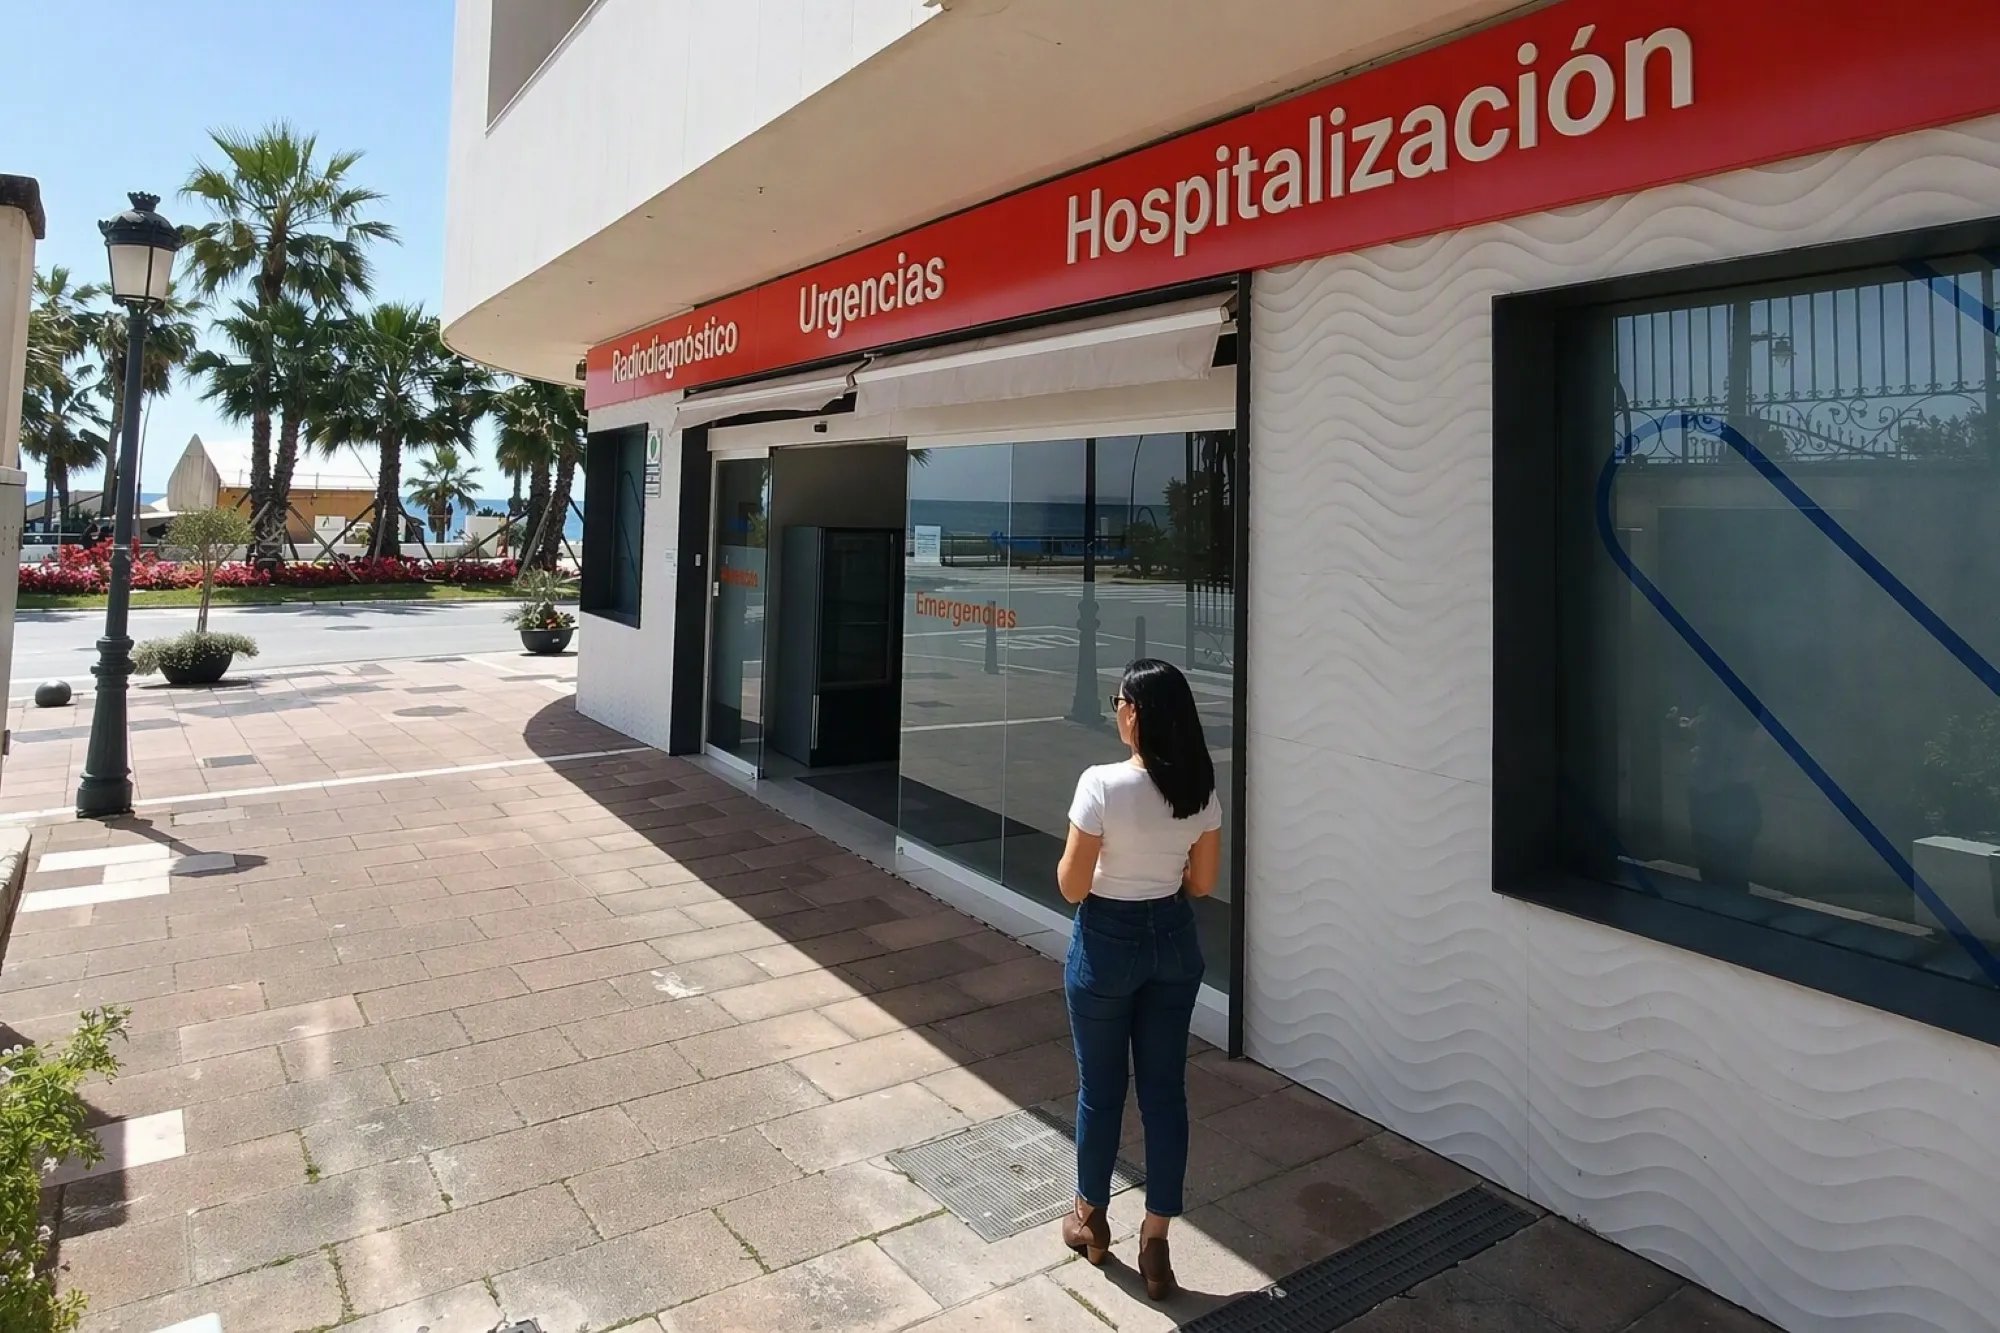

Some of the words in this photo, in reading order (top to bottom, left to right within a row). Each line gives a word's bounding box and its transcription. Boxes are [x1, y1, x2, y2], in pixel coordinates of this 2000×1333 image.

[1067, 24, 1694, 264] Hospitalización
[799, 252, 945, 339] Urgencias
[612, 316, 738, 384] Radiodiagnóstico
